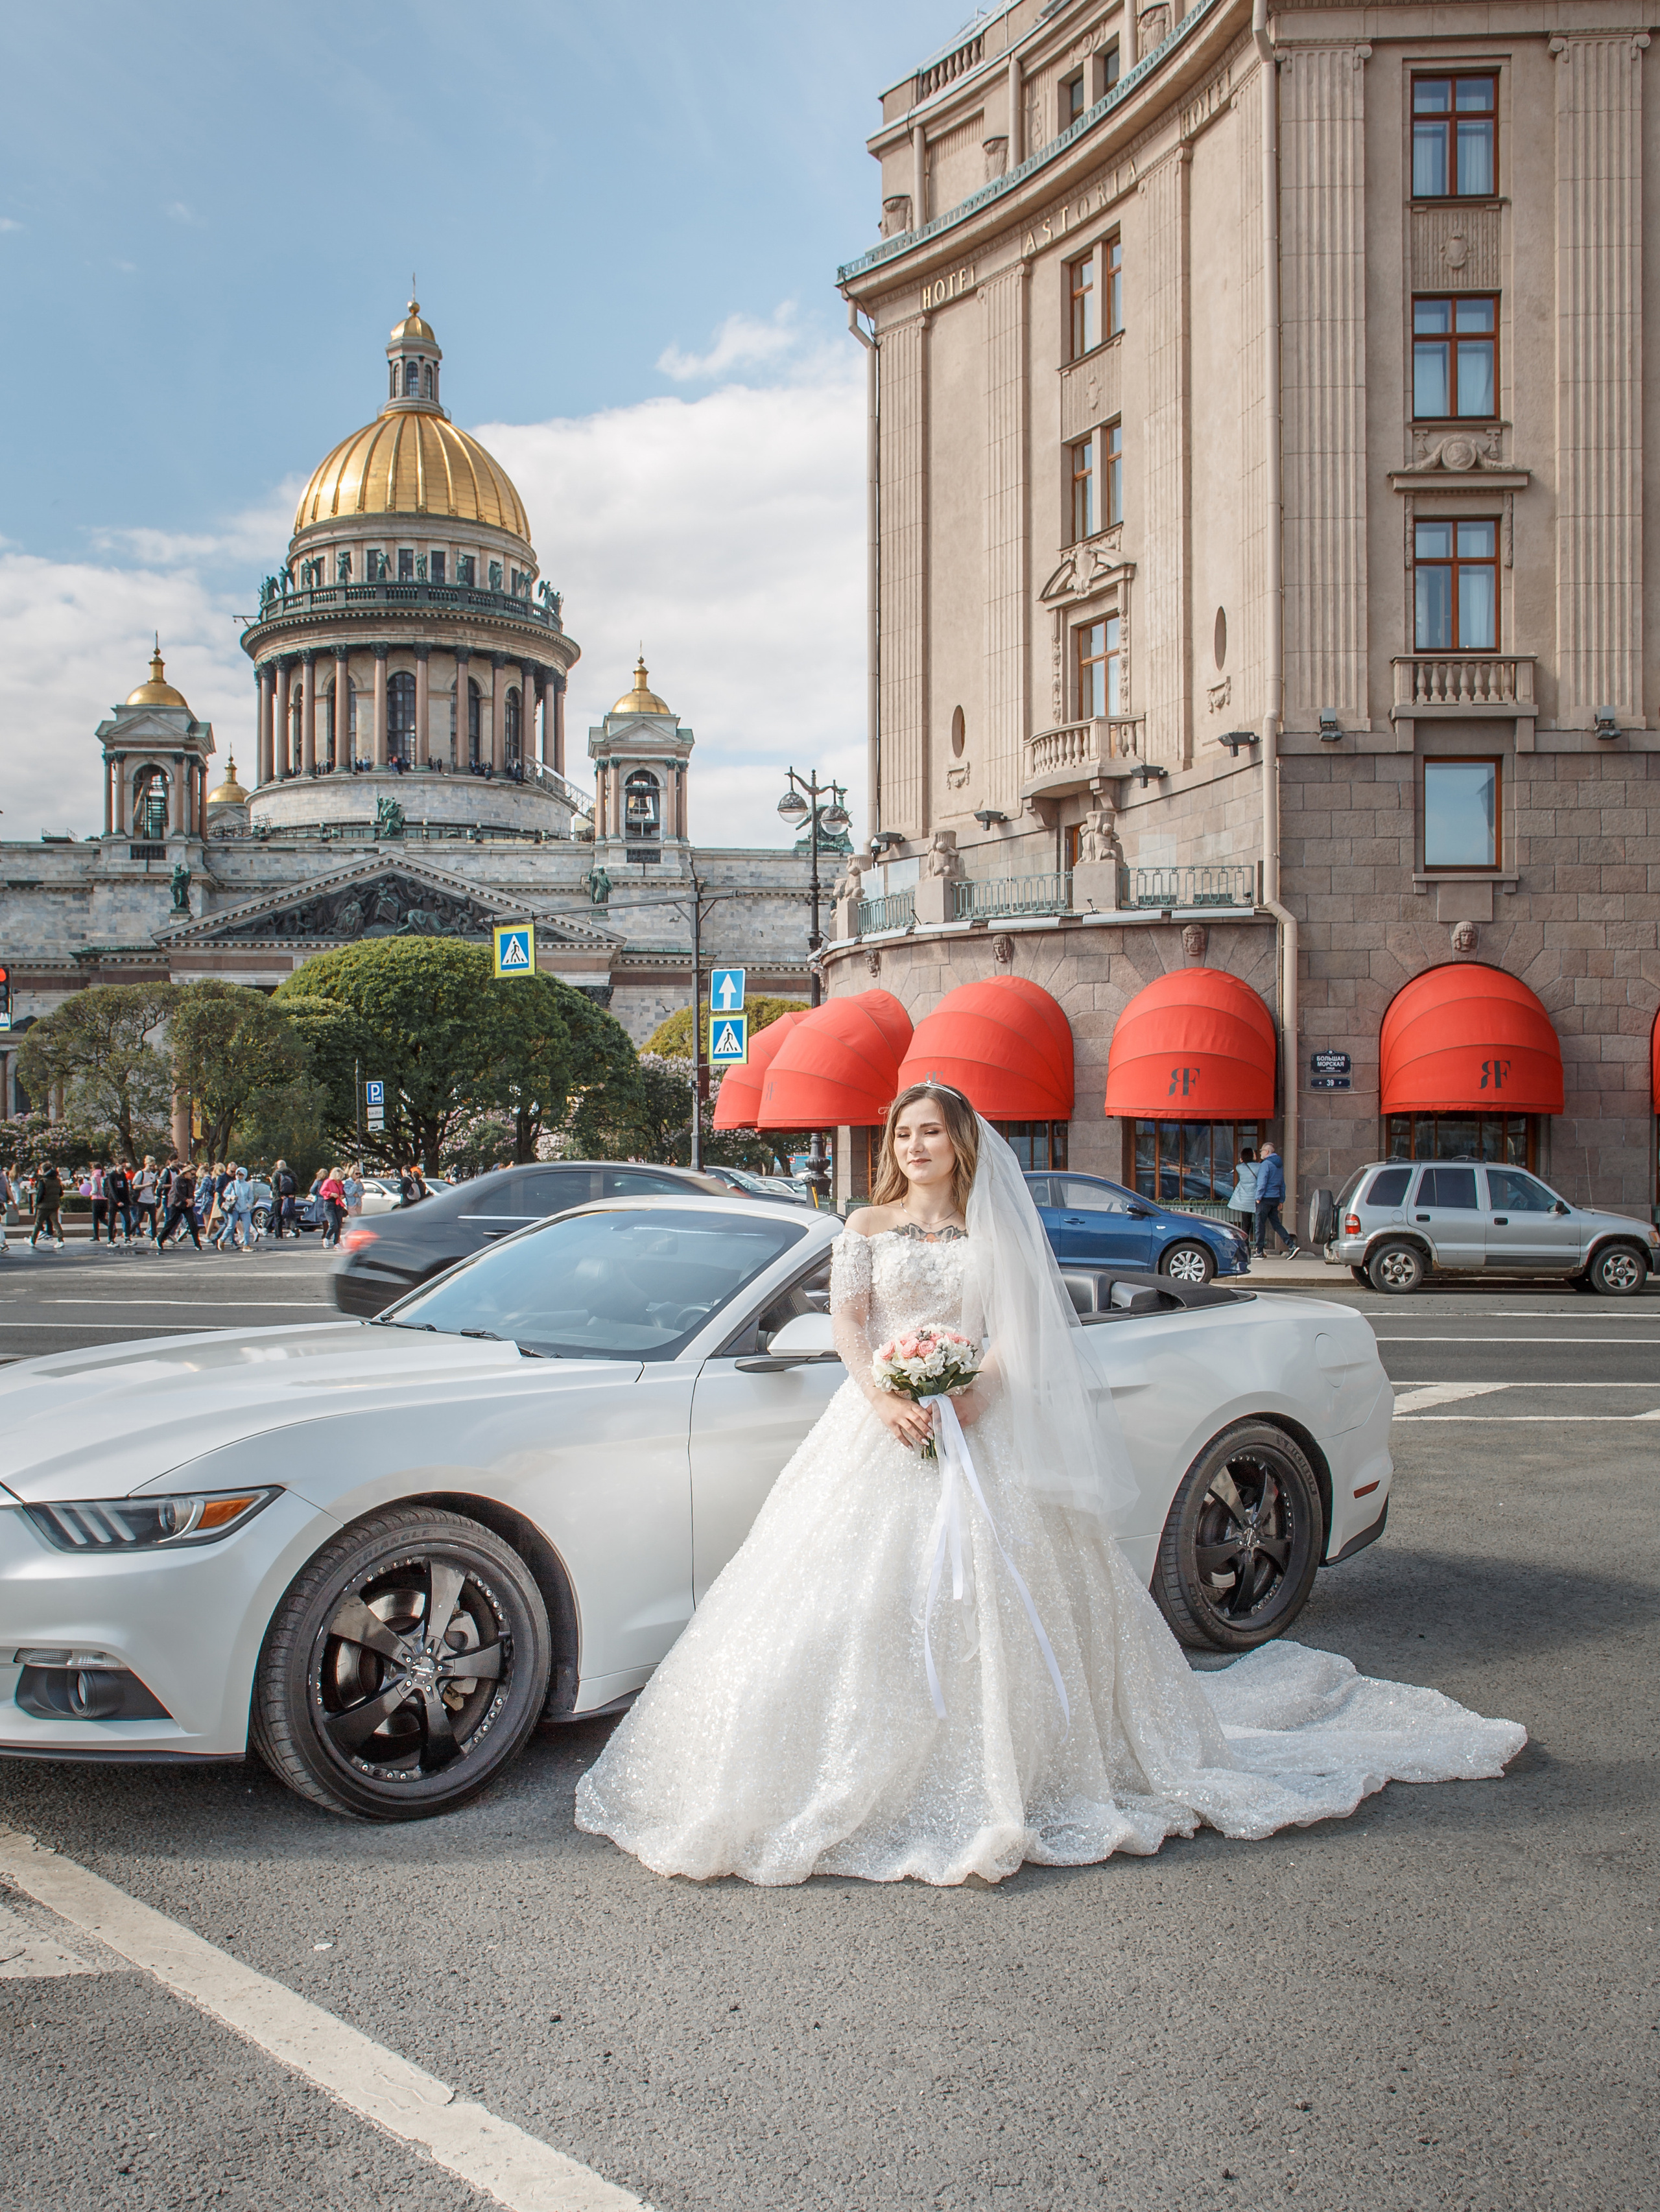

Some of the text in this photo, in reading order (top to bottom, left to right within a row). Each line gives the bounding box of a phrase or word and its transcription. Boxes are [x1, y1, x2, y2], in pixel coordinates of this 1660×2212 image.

[922, 160, 1137, 311] HOTEL ASTORIA
[353, 1529, 431, 1566] TRIANGLE
